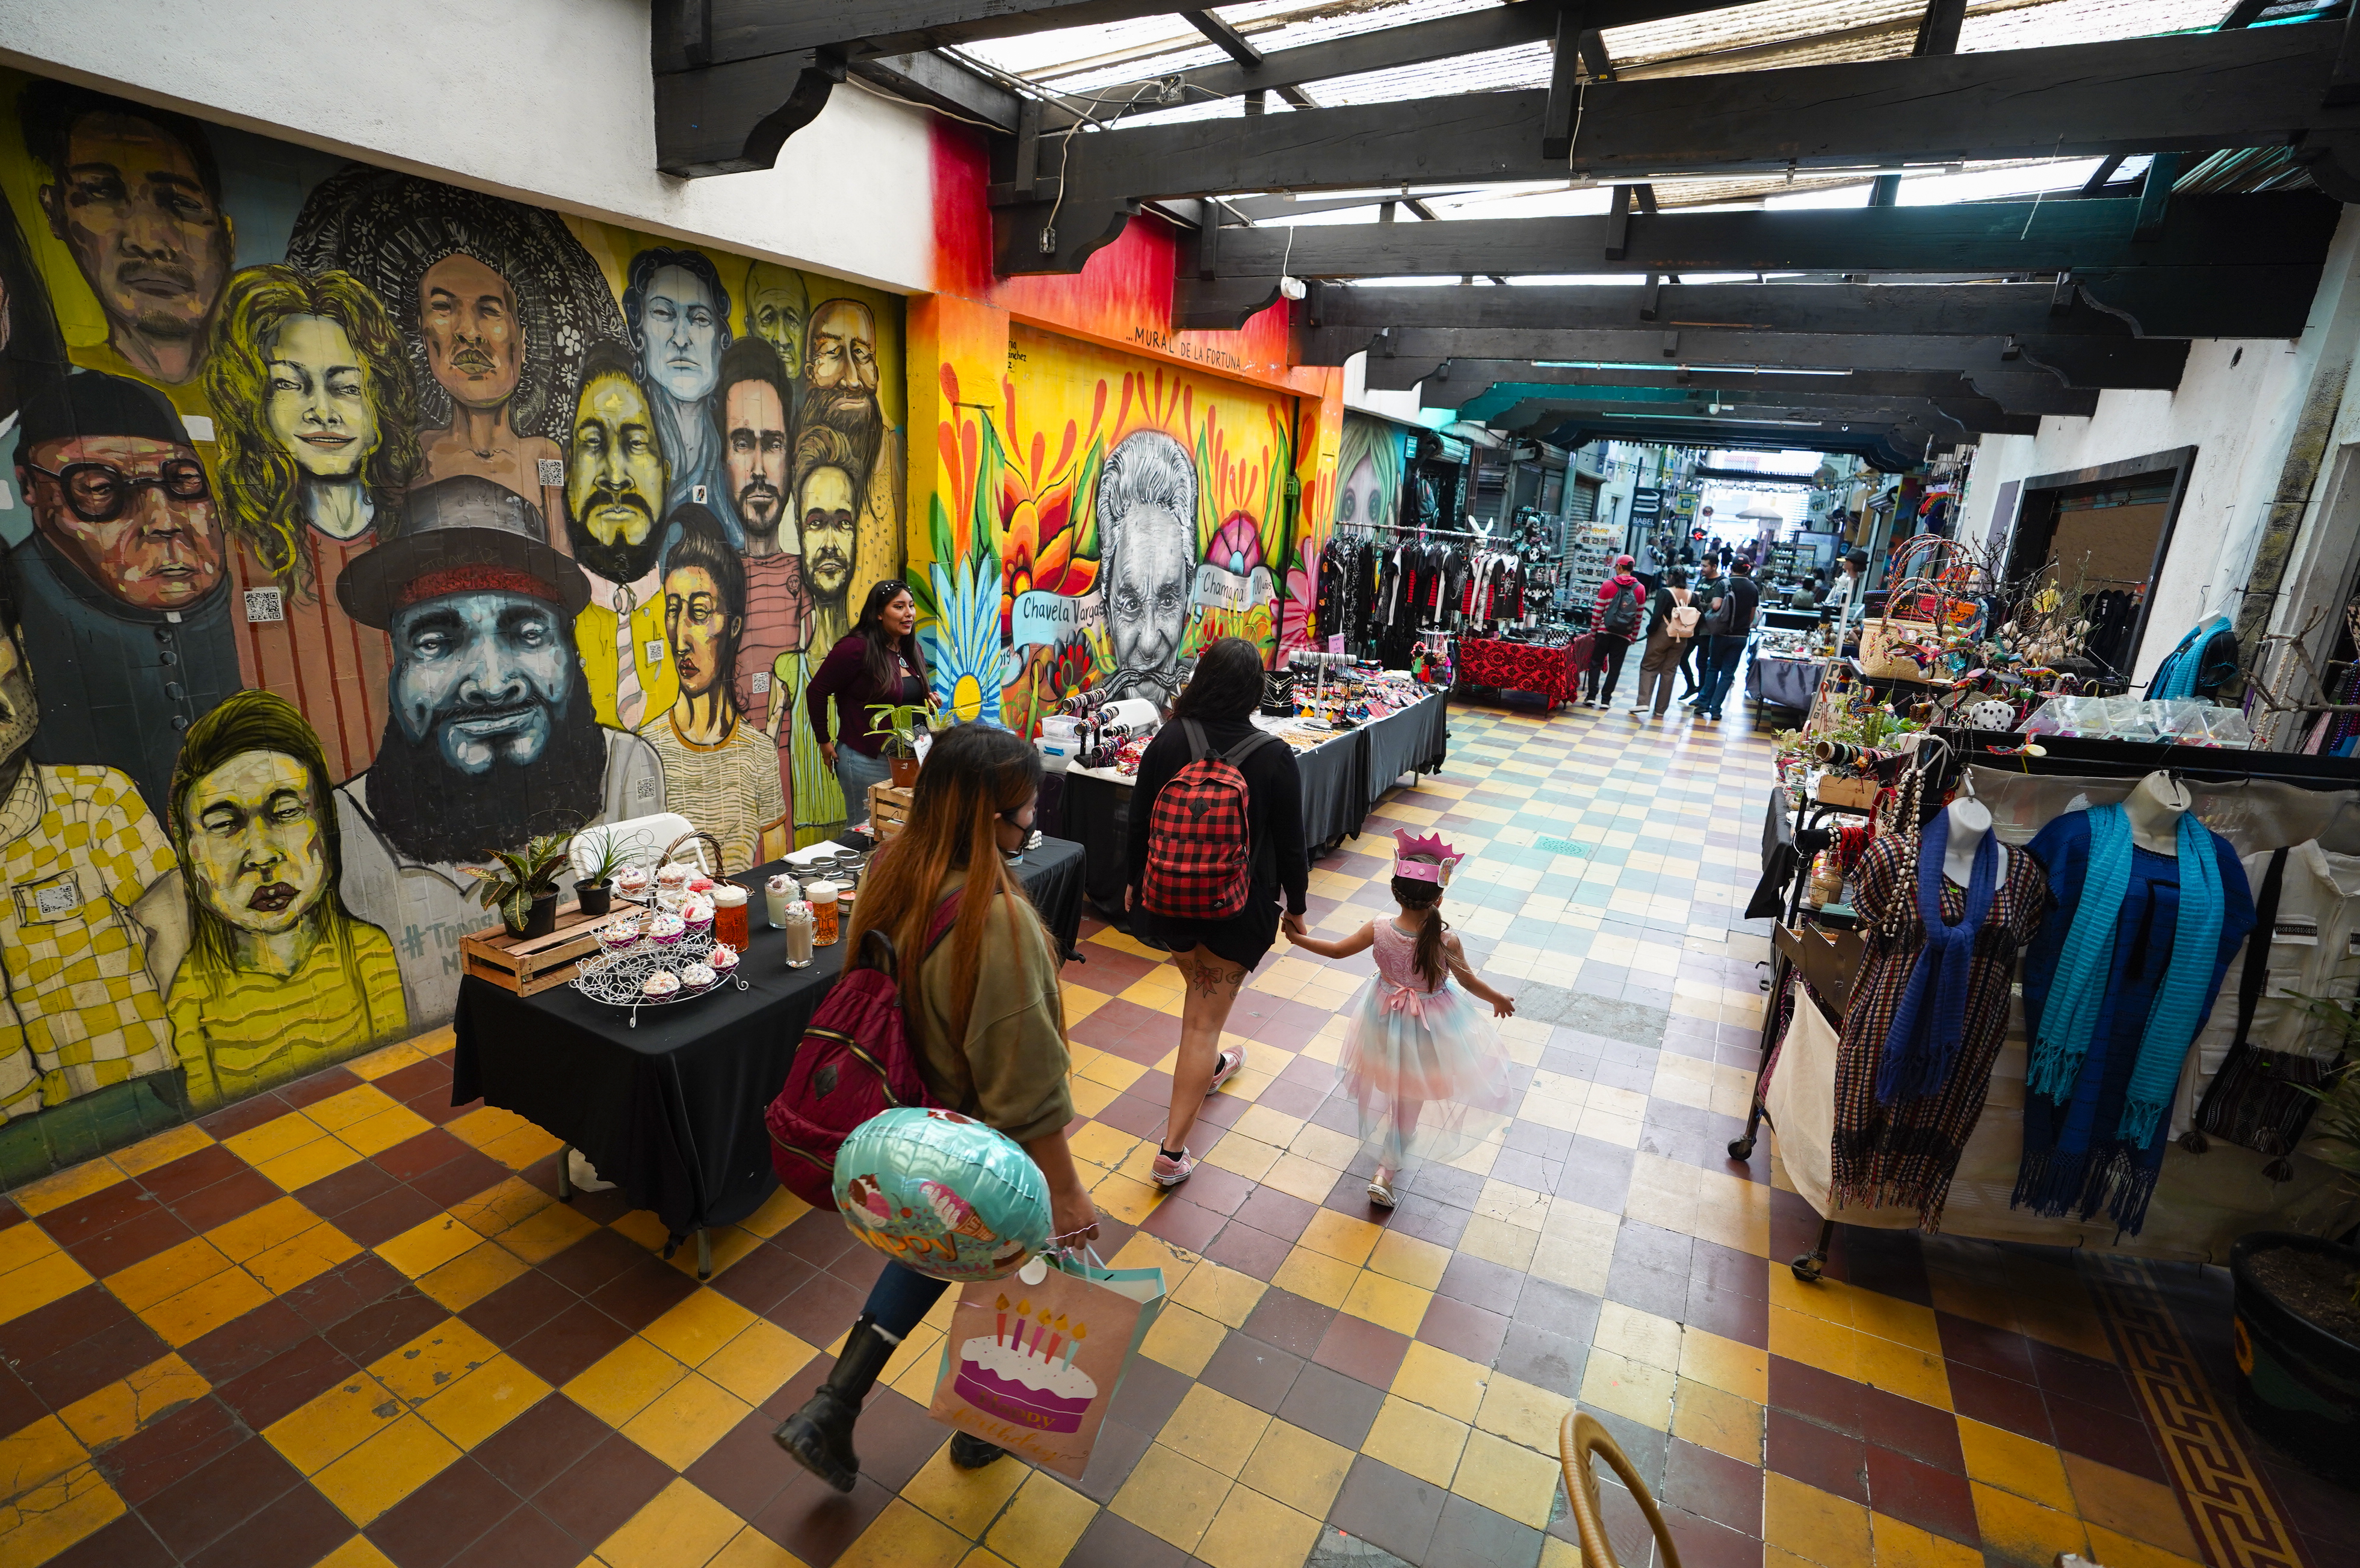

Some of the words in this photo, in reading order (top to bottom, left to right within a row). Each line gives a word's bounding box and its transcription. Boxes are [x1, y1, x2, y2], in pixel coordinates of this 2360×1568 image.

[1181, 342, 1191, 357] DE
[1194, 345, 1203, 361] LA
[1633, 517, 1655, 525] BABEL
[1203, 572, 1244, 602] Chamana
[1253, 575, 1262, 596] 100
[1024, 596, 1069, 624] Chavela
[1071, 599, 1107, 627] Vargas
